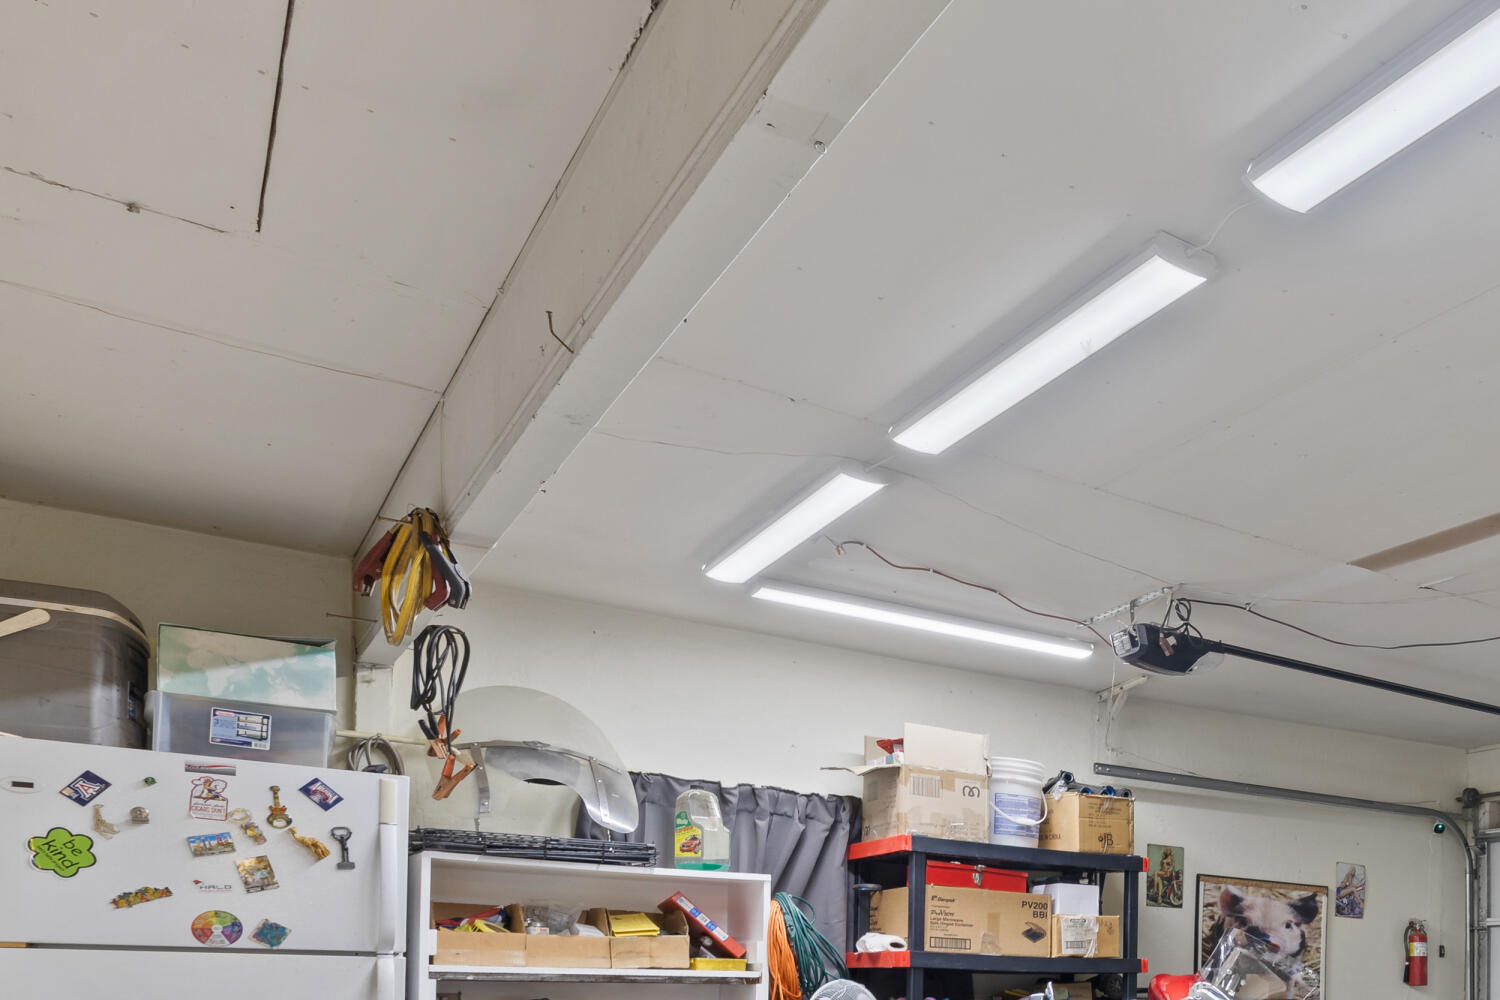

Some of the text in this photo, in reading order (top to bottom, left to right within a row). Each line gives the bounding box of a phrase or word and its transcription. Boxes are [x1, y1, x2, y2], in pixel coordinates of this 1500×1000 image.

[41, 839, 79, 869] kind
[62, 838, 82, 856] be
[1021, 900, 1048, 911] PV200
